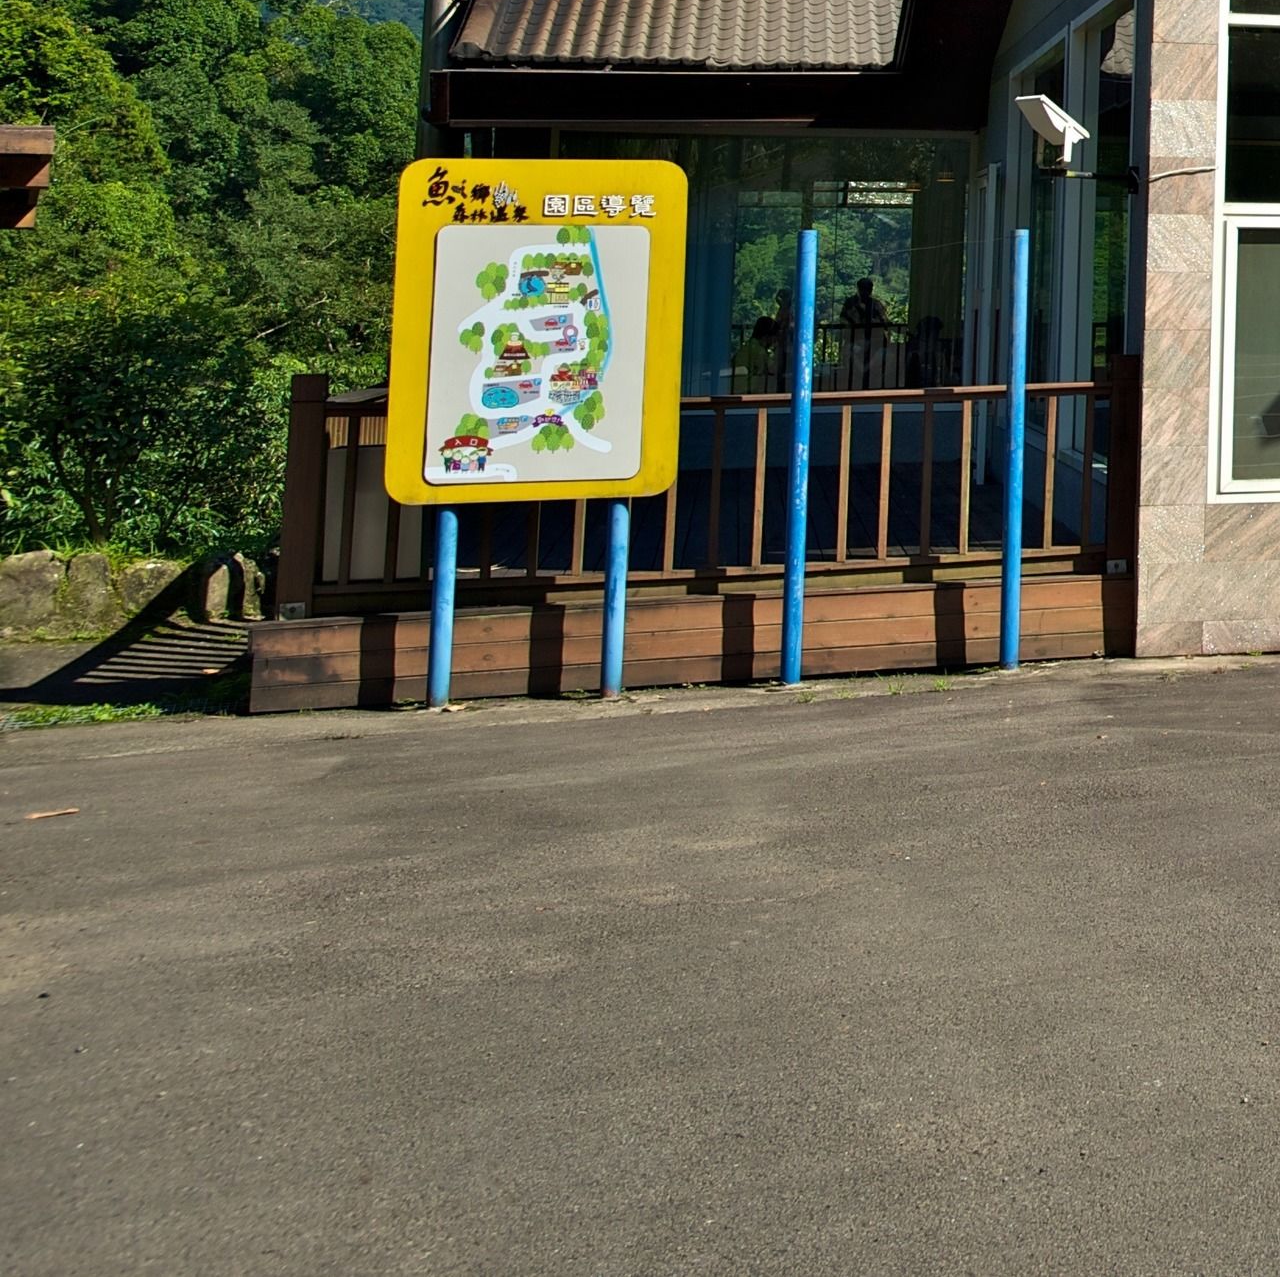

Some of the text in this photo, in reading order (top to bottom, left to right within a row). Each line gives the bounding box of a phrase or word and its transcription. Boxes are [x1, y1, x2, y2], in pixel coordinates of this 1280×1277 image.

[543, 194, 657, 218] 園區導覽
[454, 438, 479, 446] 入口
